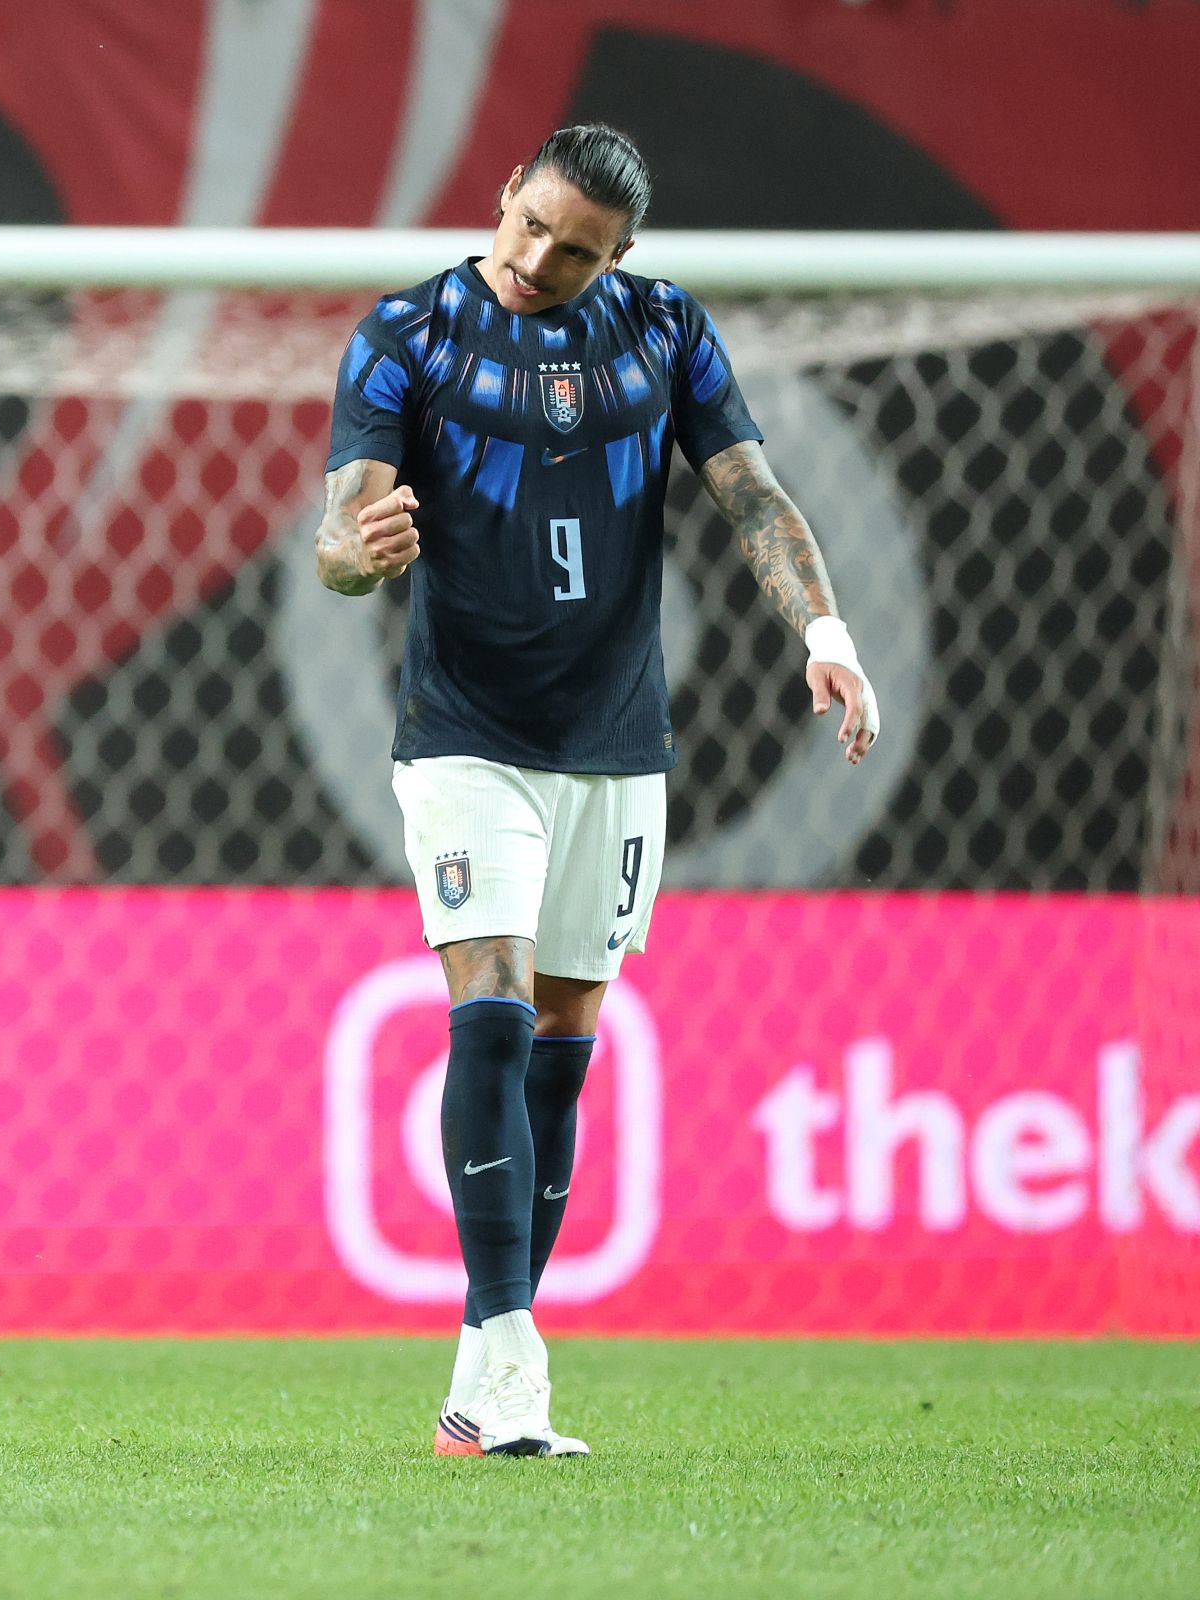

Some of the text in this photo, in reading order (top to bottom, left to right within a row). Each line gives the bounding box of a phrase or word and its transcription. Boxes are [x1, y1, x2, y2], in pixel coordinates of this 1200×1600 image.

[549, 518, 587, 600] 9
[617, 835, 644, 918] 9
[752, 1037, 1200, 1232] thek
